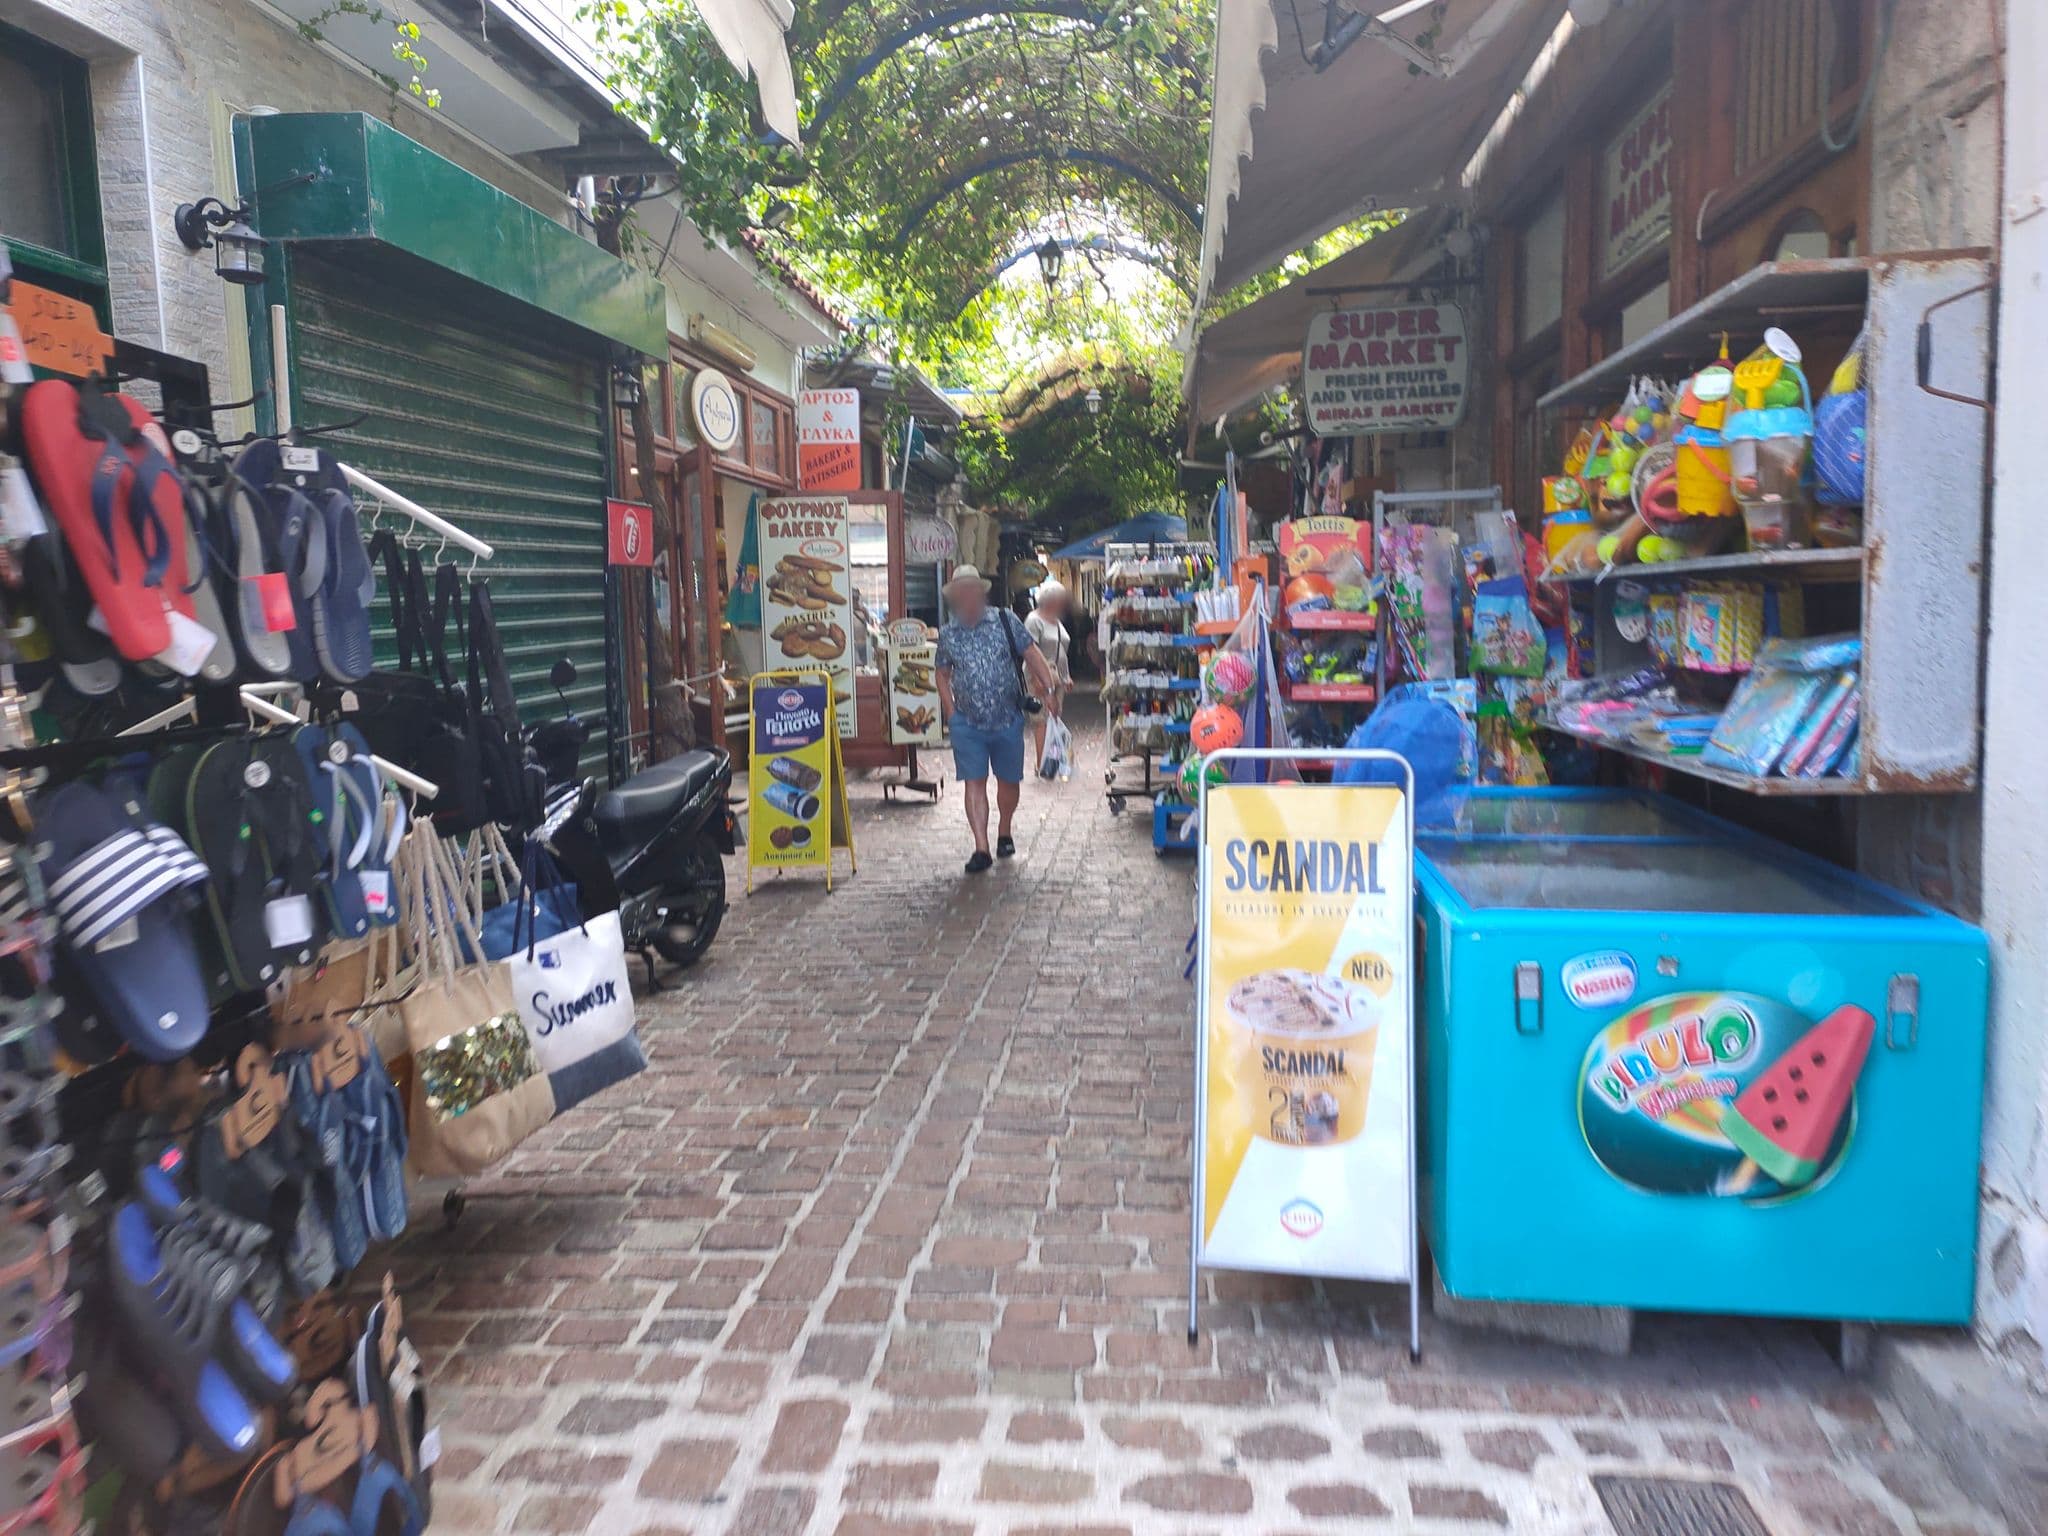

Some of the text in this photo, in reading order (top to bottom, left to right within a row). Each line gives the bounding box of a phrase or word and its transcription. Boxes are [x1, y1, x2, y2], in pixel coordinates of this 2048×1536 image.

[1621, 100, 1668, 183] SUPE
[1611, 152, 1667, 241] MARK
[1329, 308, 1441, 341] SUPER
[1308, 336, 1463, 370] MARKET
[1325, 369, 1448, 388] FRESH FRUITS
[1311, 383, 1462, 404] AND VEGETABLES
[823, 410, 834, 423] &
[1316, 402, 1456, 421] MINAS MARKET
[806, 449, 842, 472] BAKERY
[761, 502, 845, 521] ΦΟΥΡΝΟΣ
[768, 521, 838, 538] BAKERY
[1305, 517, 1345, 532] Tottis
[784, 610, 836, 625] PASTRIES
[1225, 839, 1386, 895] SCANDAL
[531, 979, 617, 1037] Summer
[1262, 1046, 1347, 1077] SCANDAL
